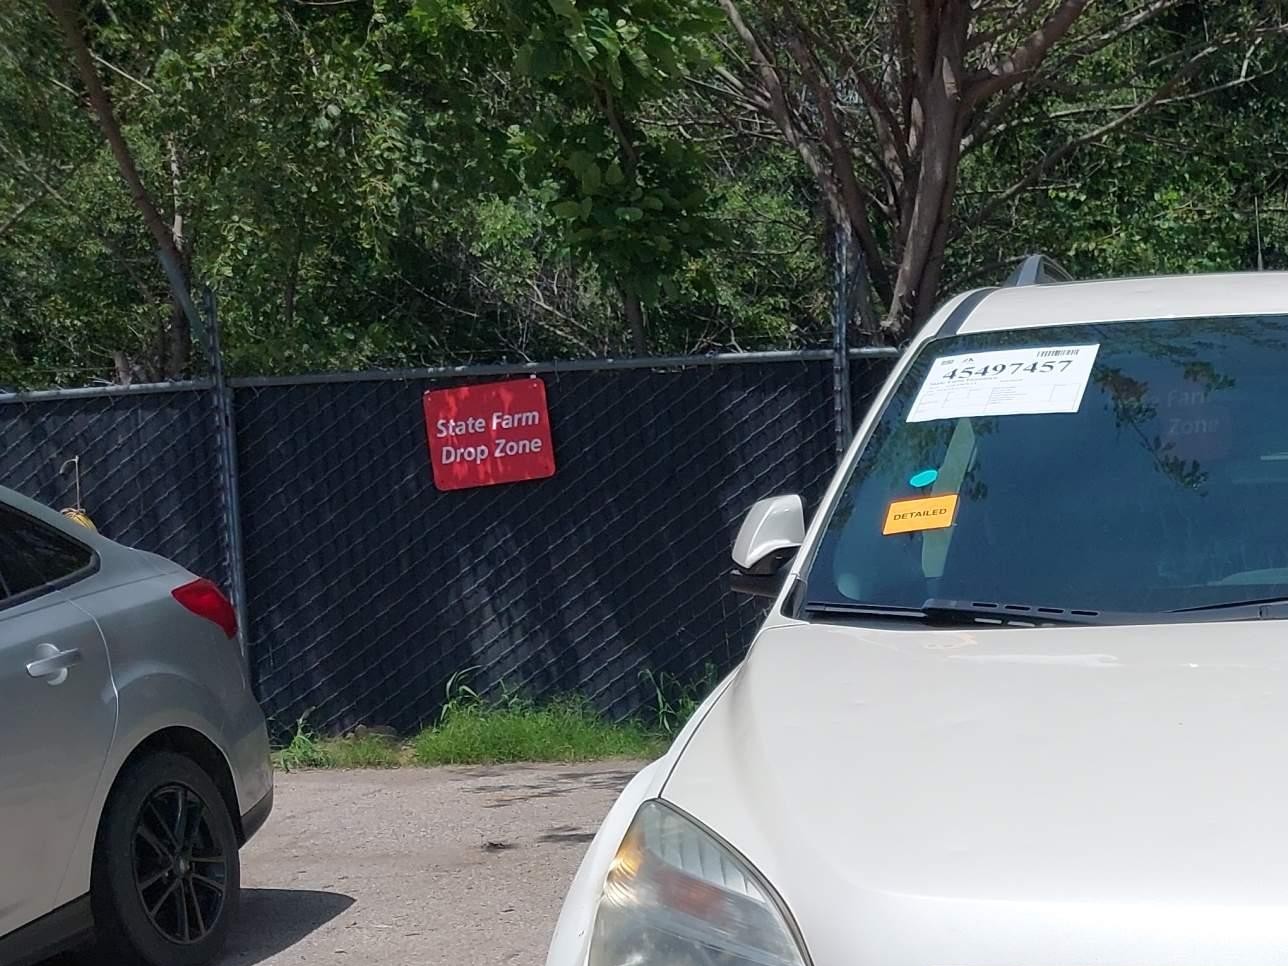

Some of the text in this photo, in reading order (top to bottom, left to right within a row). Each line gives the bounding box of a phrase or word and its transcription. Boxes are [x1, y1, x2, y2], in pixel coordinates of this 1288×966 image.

[942, 360, 1073, 380] 45497457
[437, 411, 540, 438] State Farm
[442, 438, 543, 464] Drop Zone
[893, 508, 947, 521] DETAILED
